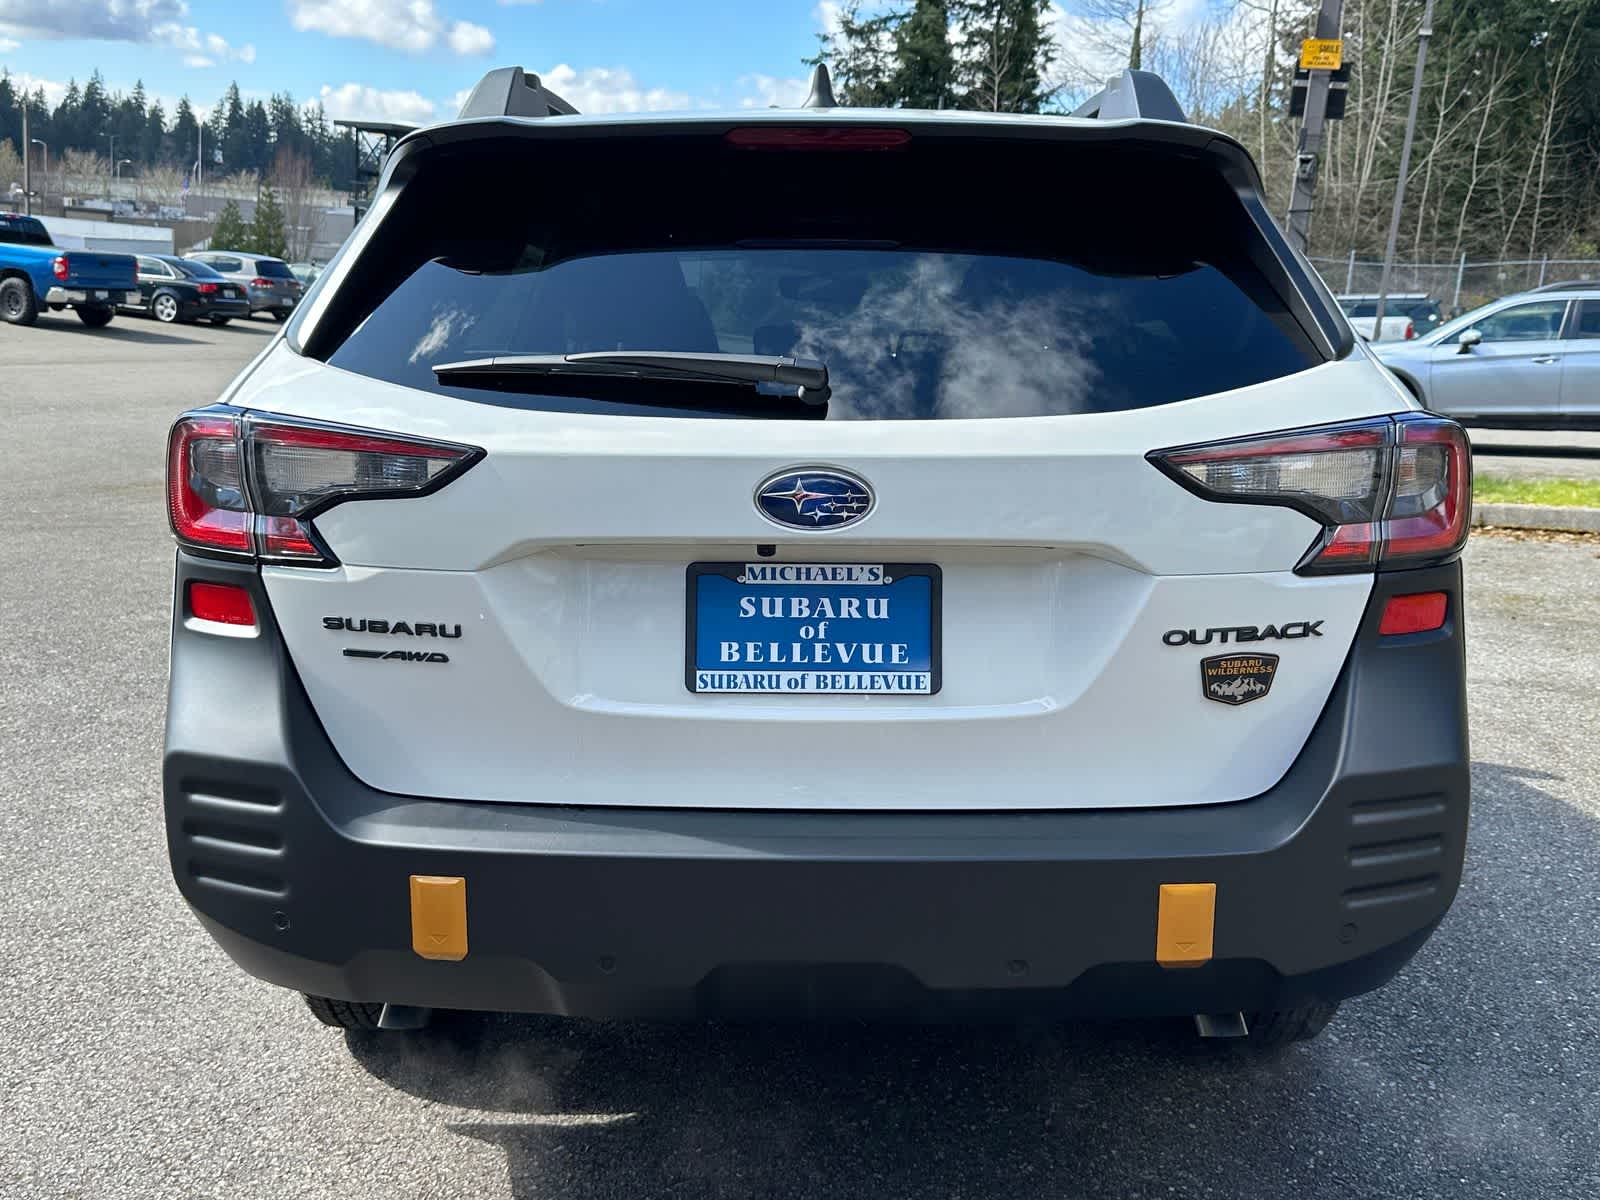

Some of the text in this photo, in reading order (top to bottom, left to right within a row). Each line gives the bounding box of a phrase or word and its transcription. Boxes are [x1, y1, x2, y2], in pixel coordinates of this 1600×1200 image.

[747, 566, 881, 582] MICHAEL'S
[739, 597, 890, 618] SUBARU
[322, 616, 462, 638] SUBARU
[799, 621, 829, 639] of
[1162, 620, 1325, 646] OUTBACK
[382, 650, 450, 663] AWD
[720, 641, 909, 664] BELLEVUE
[1207, 666, 1273, 676] WILDERNESS
[1220, 659, 1263, 668] SUBARU
[699, 674, 927, 690] SUBARU of BELLEVUE
